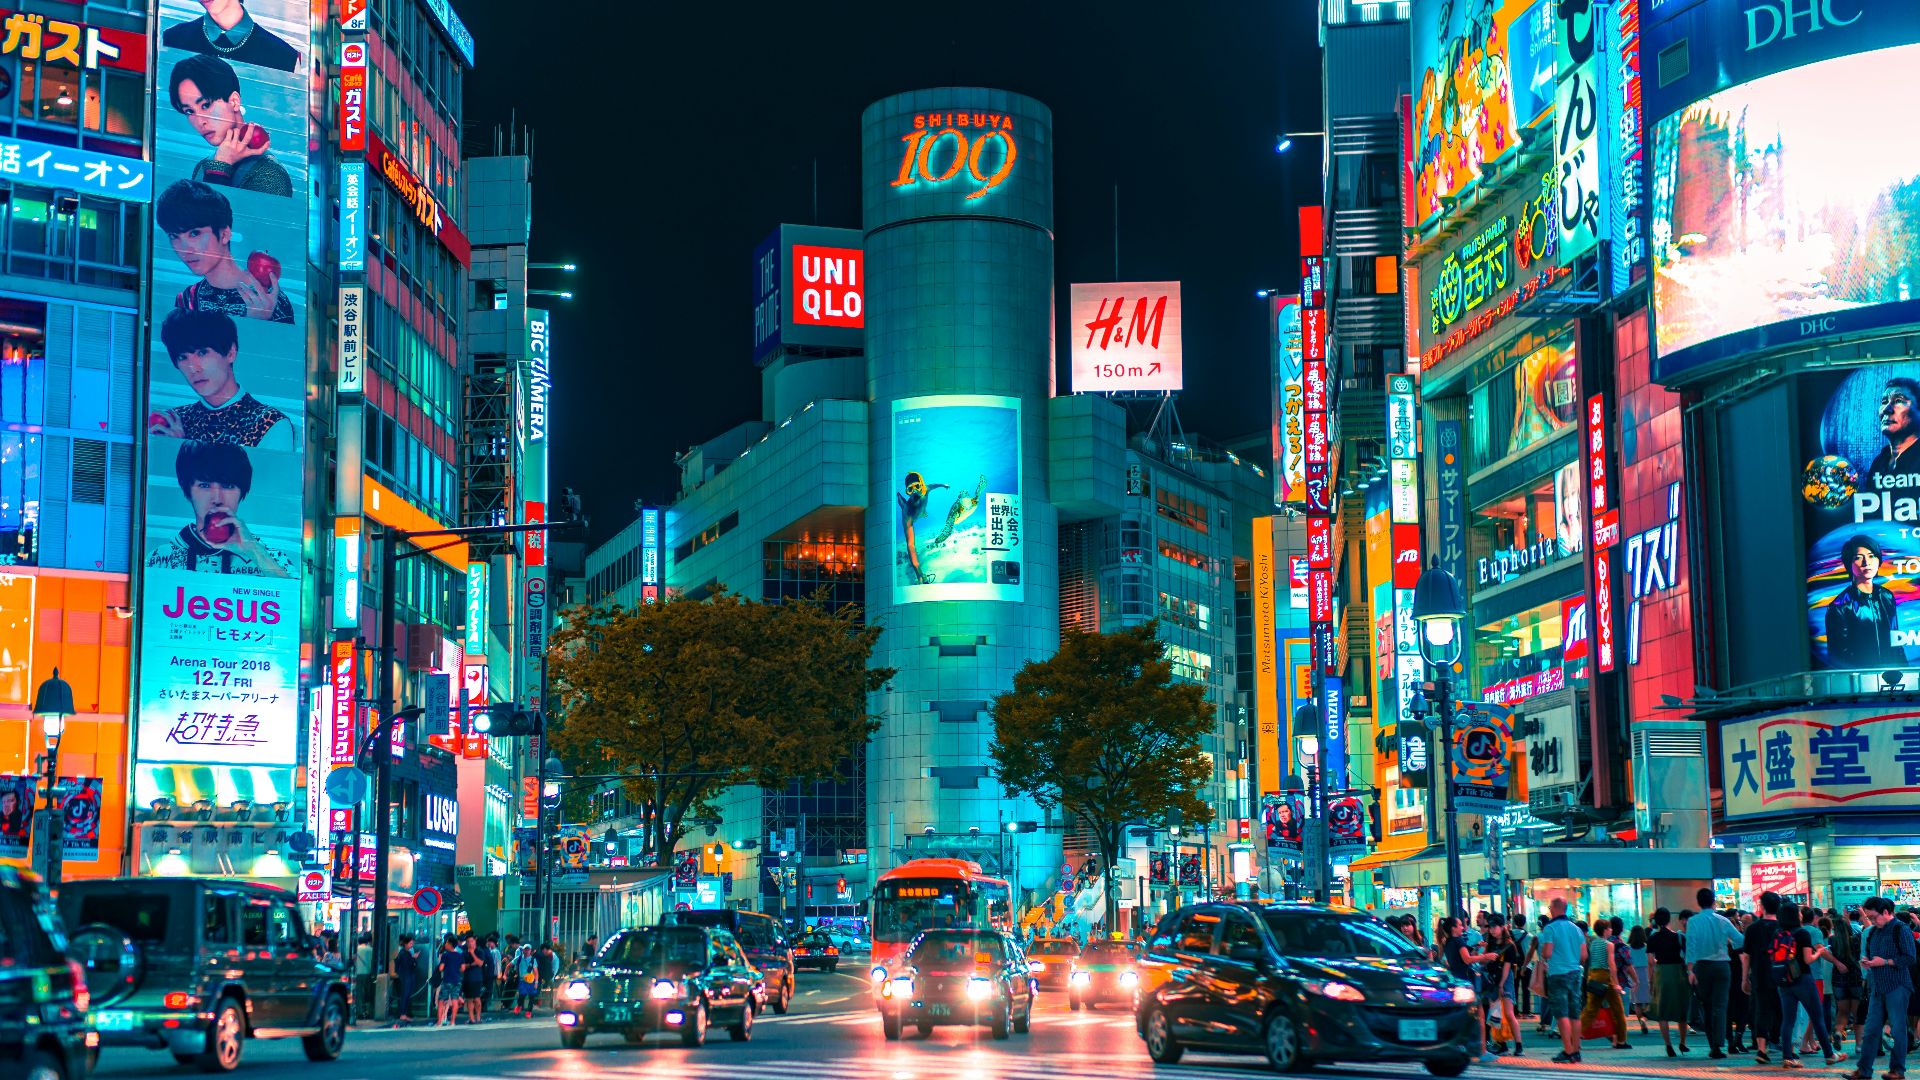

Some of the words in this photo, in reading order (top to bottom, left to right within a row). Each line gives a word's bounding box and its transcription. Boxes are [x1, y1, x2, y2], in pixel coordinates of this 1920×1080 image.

[351, 19, 364, 28] 8F
[1745, 0, 1862, 50] DHC
[3, 13, 120, 70] ガスト
[345, 88, 362, 140] ガスト
[914, 114, 1012, 131] SHIBUYA
[890, 128, 1017, 200] 109
[759, 247, 775, 292] THE
[802, 255, 856, 286] UNI
[754, 289, 780, 348] PRIME
[802, 289, 862, 320] QLO
[530, 320, 545, 353] BIC
[1085, 295, 1168, 350] H&M
[1800, 317, 1836, 336] DHC
[342, 293, 358, 386] 渋谷駅前ビル
[1094, 364, 1144, 378] 150m
[991, 505, 1019, 517] 世界に
[1853, 492, 1920, 523] Pla
[1396, 549, 1418, 563] JTB
[1477, 534, 1553, 584] Euphoria
[232, 587, 250, 595] NEW
[252, 588, 280, 598] SINGLE
[470, 566, 481, 599] レイク
[527, 577, 546, 608] OS
[162, 586, 281, 625] Jesus
[468, 600, 480, 643] ALSA
[529, 608, 543, 659] 調剤薬局
[1262, 601, 1270, 674] Matsumoto
[170, 656, 207, 668] Arena
[211, 658, 238, 669] Tour
[241, 660, 271, 671] 2018
[192, 669, 231, 687] 12.7
[234, 677, 252, 687] FRI
[159, 688, 279, 703] さいたまスーパーアリーナ
[1401, 673, 1411, 706] フルーツ
[166, 712, 268, 746] 超特急
[336, 675, 351, 755] サンドラッグ
[1327, 690, 1338, 740] MIZUHO
[1407, 736, 1427, 771] HUB
[1466, 787, 1477, 796] Tik
[1480, 790, 1494, 798] Tok
[426, 794, 458, 835] LUSH
[1740, 834, 1768, 842] TAISEIDO
